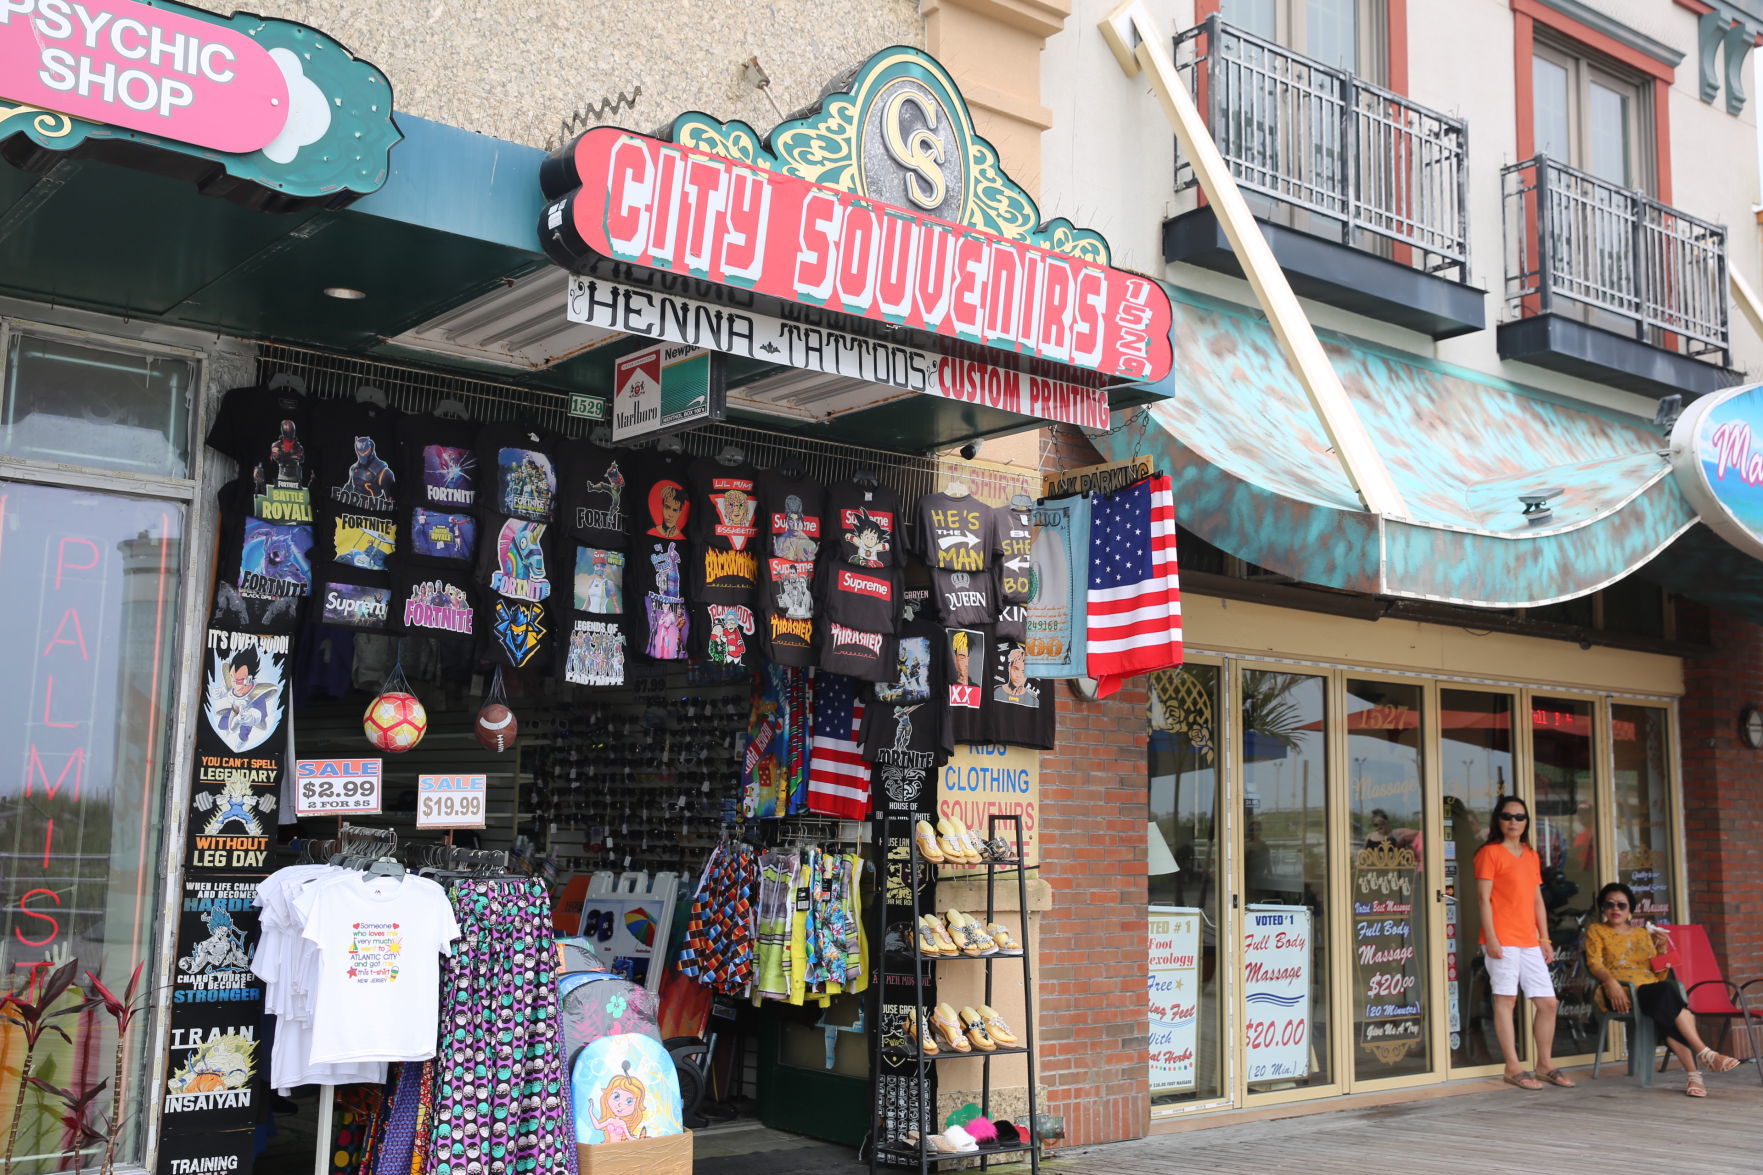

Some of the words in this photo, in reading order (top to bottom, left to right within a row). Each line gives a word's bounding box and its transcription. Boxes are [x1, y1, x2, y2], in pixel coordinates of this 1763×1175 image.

[0, 0, 236, 84] PSYCHIC
[38, 47, 194, 118] SHOP
[603, 134, 772, 281] CITY
[794, 189, 1108, 368] SOUVENIRS
[1114, 278, 1153, 378] 1529
[585, 280, 756, 358] HENNA
[779, 322, 927, 392] TATTOOS
[938, 356, 1021, 413] CUSTOM
[1030, 377, 1110, 430] PRINTING
[571, 398, 603, 416] 1529
[616, 400, 659, 429] Marlboro
[715, 480, 730, 488] LIL
[1048, 475, 1078, 497] ASK
[1080, 463, 1150, 497] PARKING
[272, 490, 305, 503] BATTLE
[341, 513, 394, 535] FORTNITE
[931, 509, 981, 530] HE'S
[936, 529, 960, 537] THE
[938, 549, 985, 571] MAN
[242, 570, 309, 598] FORTNITE
[491, 573, 551, 601] FORTNITE
[843, 572, 889, 595] Supreme
[325, 591, 388, 616] Suprem
[945, 591, 986, 610] QUEEN
[404, 599, 474, 635] FORTNITE
[575, 620, 606, 633] LEGENDS
[607, 623, 619, 635] OF
[771, 614, 813, 644] THRASHER
[207, 629, 229, 650] IT'S
[831, 622, 883, 657] THRASHER
[1359, 704, 1409, 730] 1527
[202, 756, 221, 767] YOU
[222, 757, 249, 769] CAN'T
[251, 759, 278, 770] SPELL
[876, 750, 934, 768] FORTNITE
[200, 767, 278, 783] LEGENDARY
[297, 762, 379, 776] SALE
[419, 776, 485, 791] SALE
[945, 766, 1030, 794] CLOTHING
[302, 780, 375, 799] $2.99
[321, 800, 350, 808] FOR
[353, 798, 371, 807] $5
[422, 796, 481, 818] $19.99
[889, 802, 909, 811] HOUSE
[910, 802, 919, 812] OF
[940, 799, 1035, 833] SOUVENIRS
[195, 837, 269, 850] WITHOUT
[193, 850, 227, 868] LEG
[232, 850, 268, 868] DAY
[186, 882, 214, 891] WHEN
[214, 882, 233, 891] LIFE
[197, 891, 216, 899] AND
[218, 891, 258, 900] BECOMES
[184, 898, 256, 912] HARDE
[1372, 900, 1386, 913] Best
[1386, 900, 1411, 914] Massage
[360, 922, 392, 930] Someone
[1174, 921, 1182, 934] #
[1185, 920, 1191, 934] 1
[1255, 915, 1283, 926] VOTED
[1289, 915, 1294, 926] 1
[1357, 921, 1382, 940] Full
[1384, 920, 1410, 939] Body
[372, 938, 393, 946] much
[1148, 937, 1173, 950] Foot
[1245, 934, 1270, 954] Full
[1275, 932, 1305, 952] Body
[350, 953, 381, 961] ATLANTIC
[382, 953, 398, 961] CITY
[1149, 952, 1194, 967] exology
[1358, 945, 1414, 965] Massage
[357, 968, 369, 976] this
[370, 968, 391, 976] t-shirt
[369, 962, 381, 970] got
[1245, 962, 1302, 987] Massage
[177, 974, 214, 983] CHANGE
[192, 982, 206, 991] TO
[207, 981, 247, 991] BECOME
[1148, 975, 1173, 992] Free
[174, 988, 260, 1004] STRONGER
[1170, 1003, 1196, 1021] Feet
[171, 1026, 254, 1048] TRAIN
[1246, 1018, 1305, 1049] $20.00
[1397, 1022, 1405, 1035] A
[1405, 1021, 1419, 1037] Try
[1164, 1047, 1193, 1065] Herbs
[164, 1092, 251, 1114] INSAIYAN
[170, 1155, 238, 1175] TRAINING
